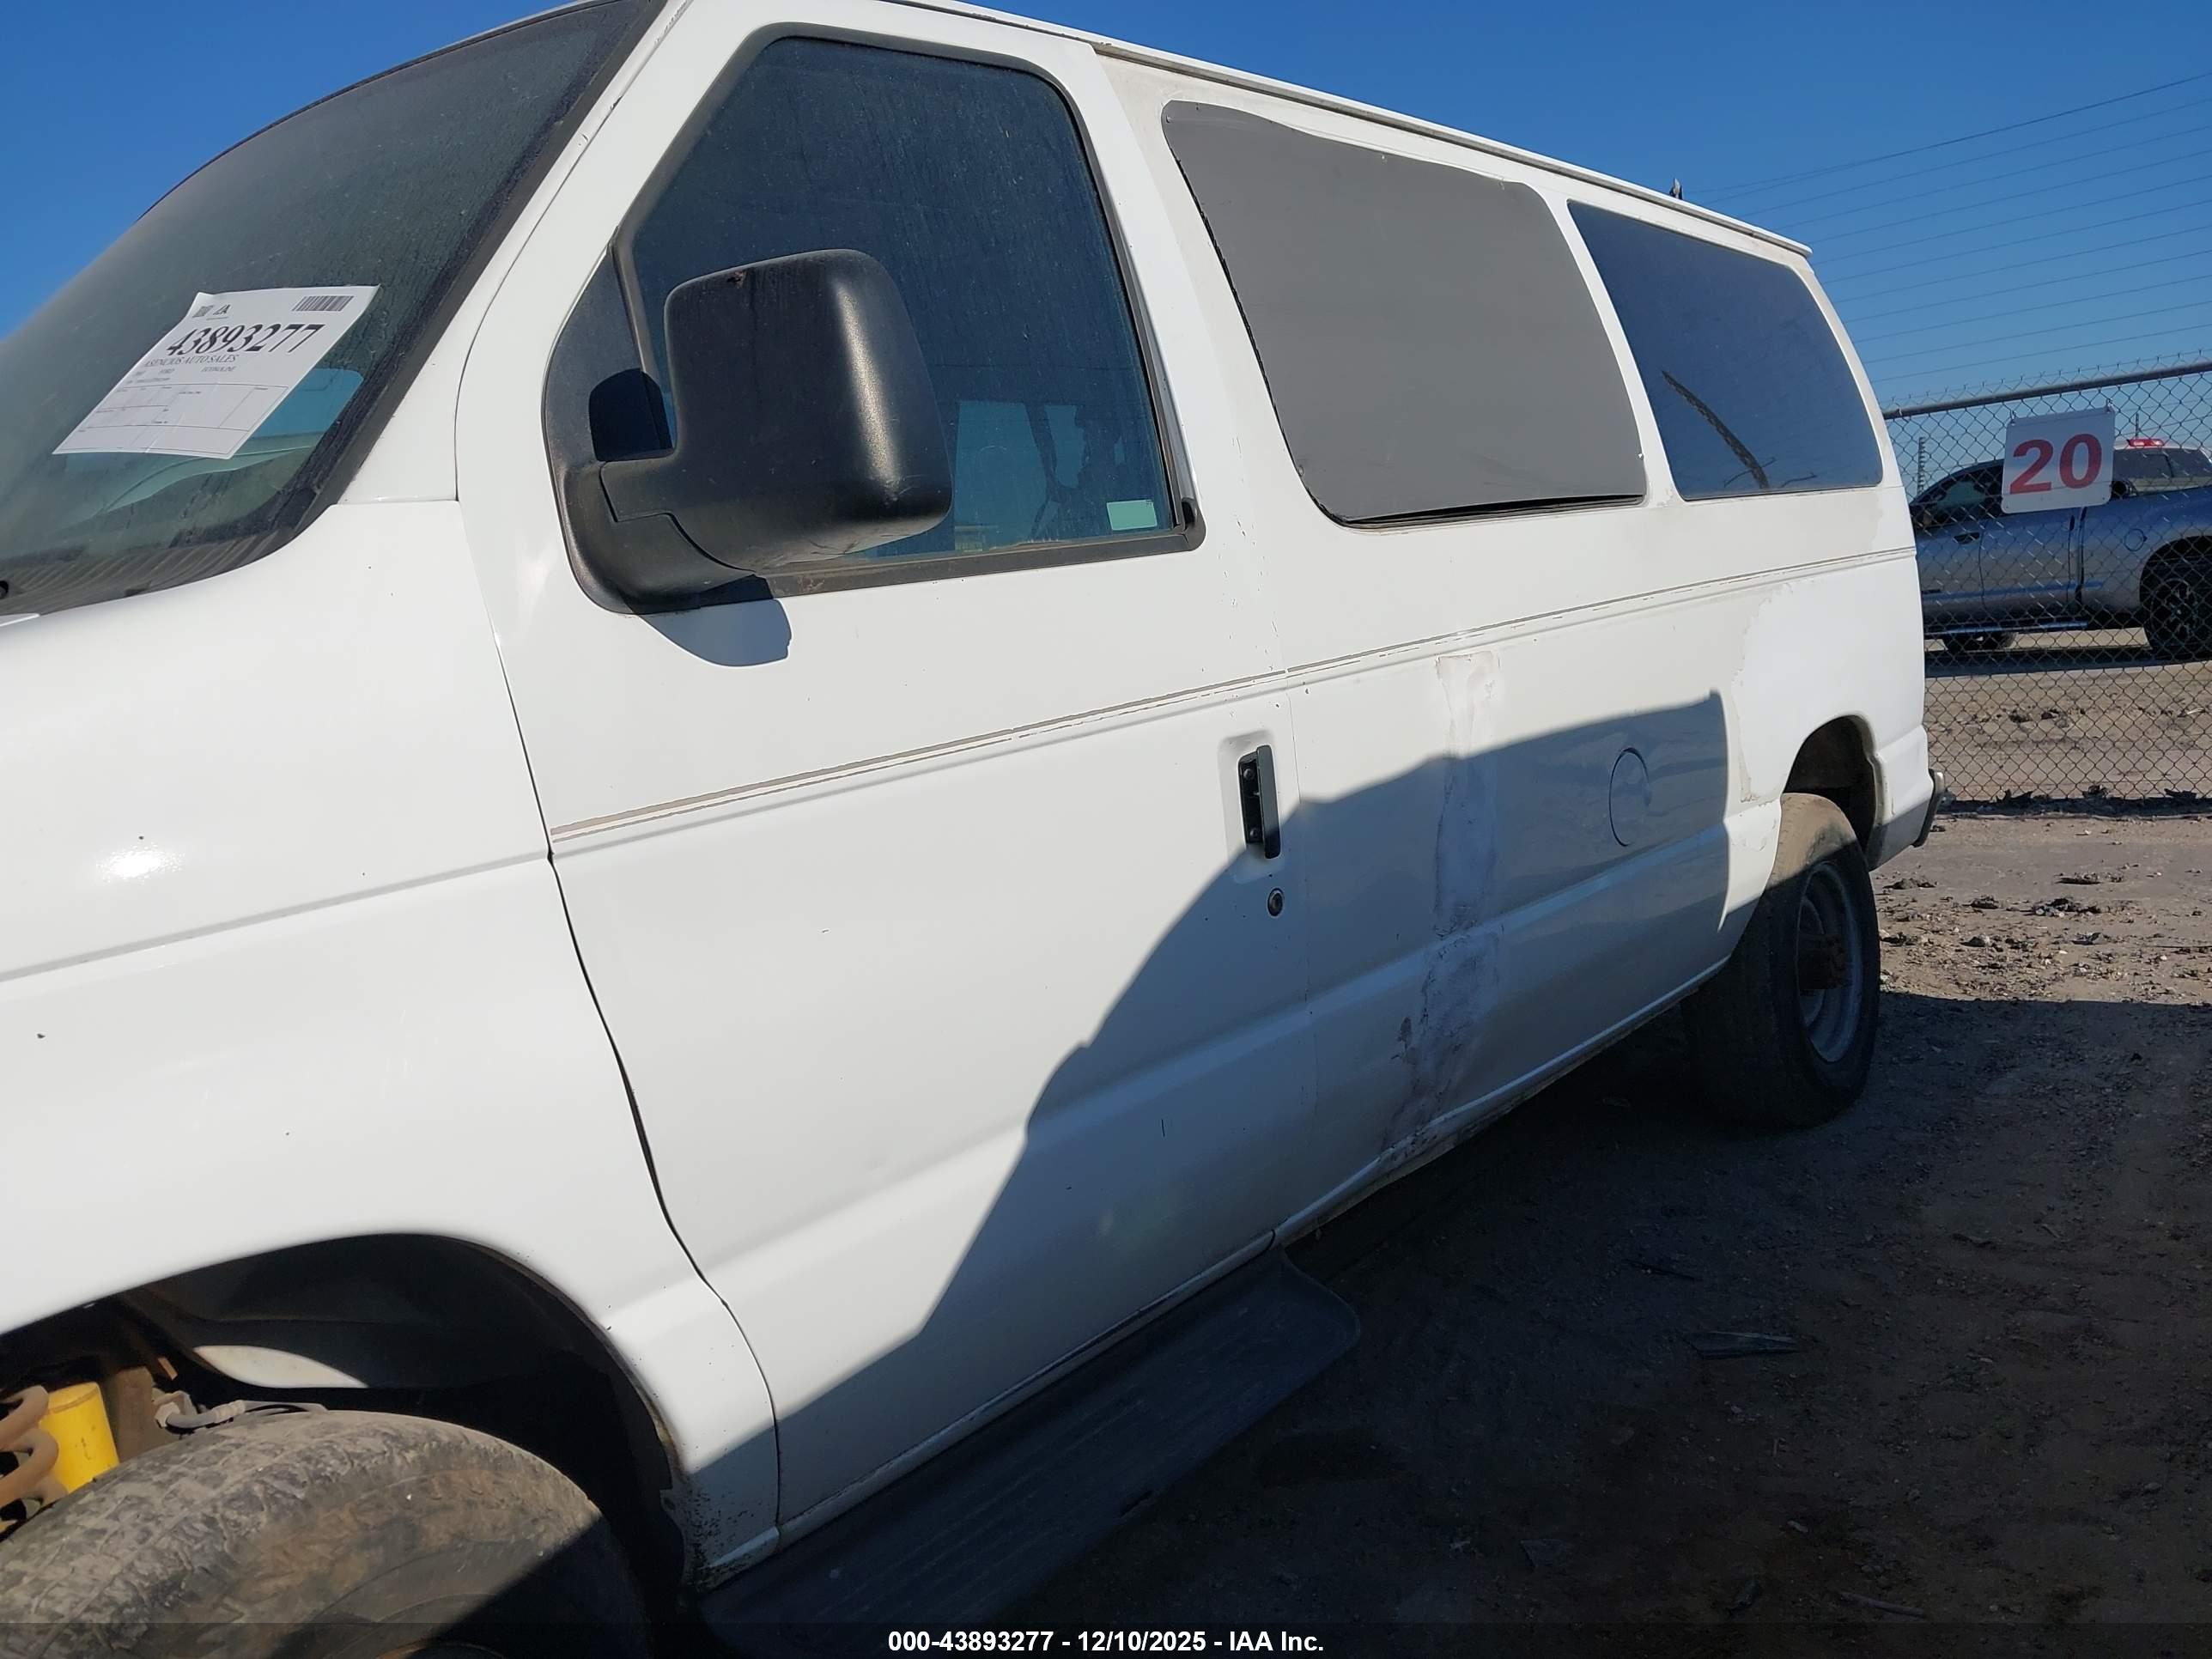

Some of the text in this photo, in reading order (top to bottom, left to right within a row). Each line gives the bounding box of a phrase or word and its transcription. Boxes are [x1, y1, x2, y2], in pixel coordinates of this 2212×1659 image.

[167, 324, 325, 356] 43893277
[207, 354, 239, 363] SALES
[2009, 433, 2102, 495] 20
